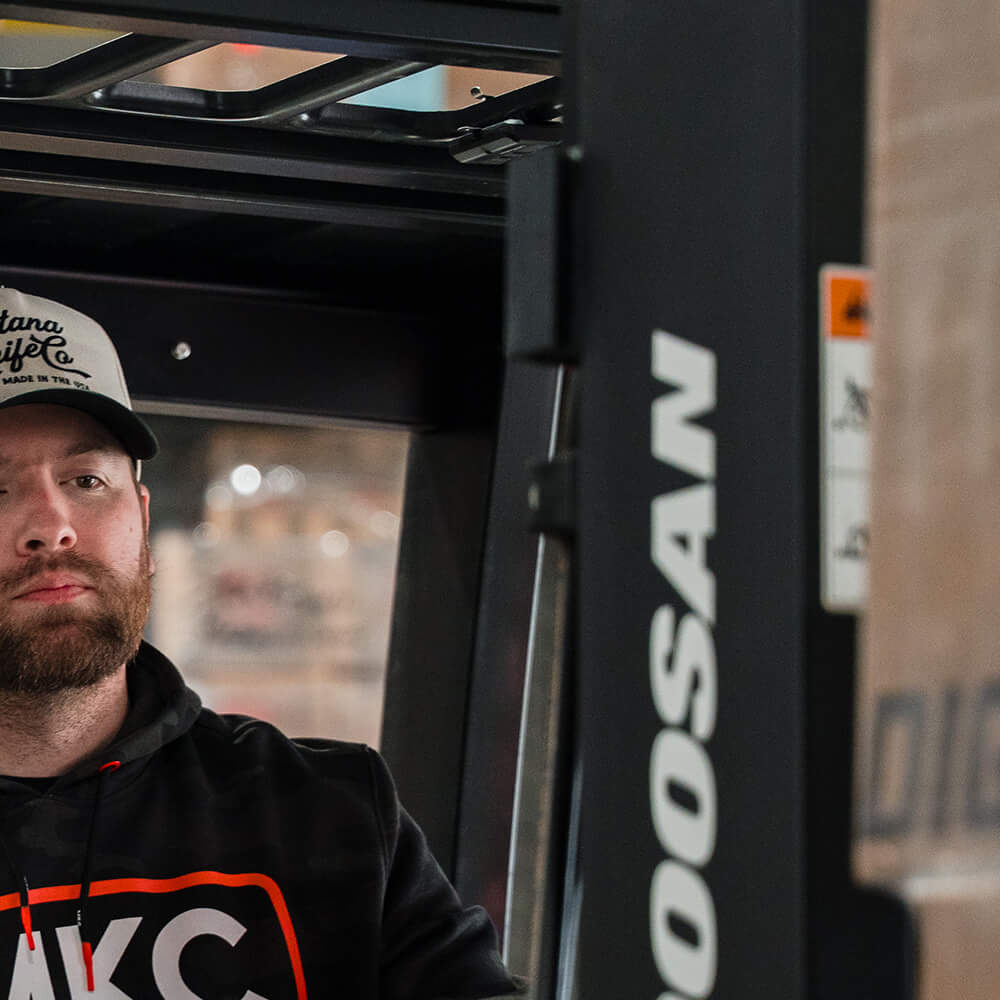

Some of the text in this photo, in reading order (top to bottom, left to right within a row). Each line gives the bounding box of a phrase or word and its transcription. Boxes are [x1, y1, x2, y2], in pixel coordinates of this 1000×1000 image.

[2, 375, 34, 385] MADE
[37, 375, 49, 383] IN
[51, 376, 72, 386] THE
